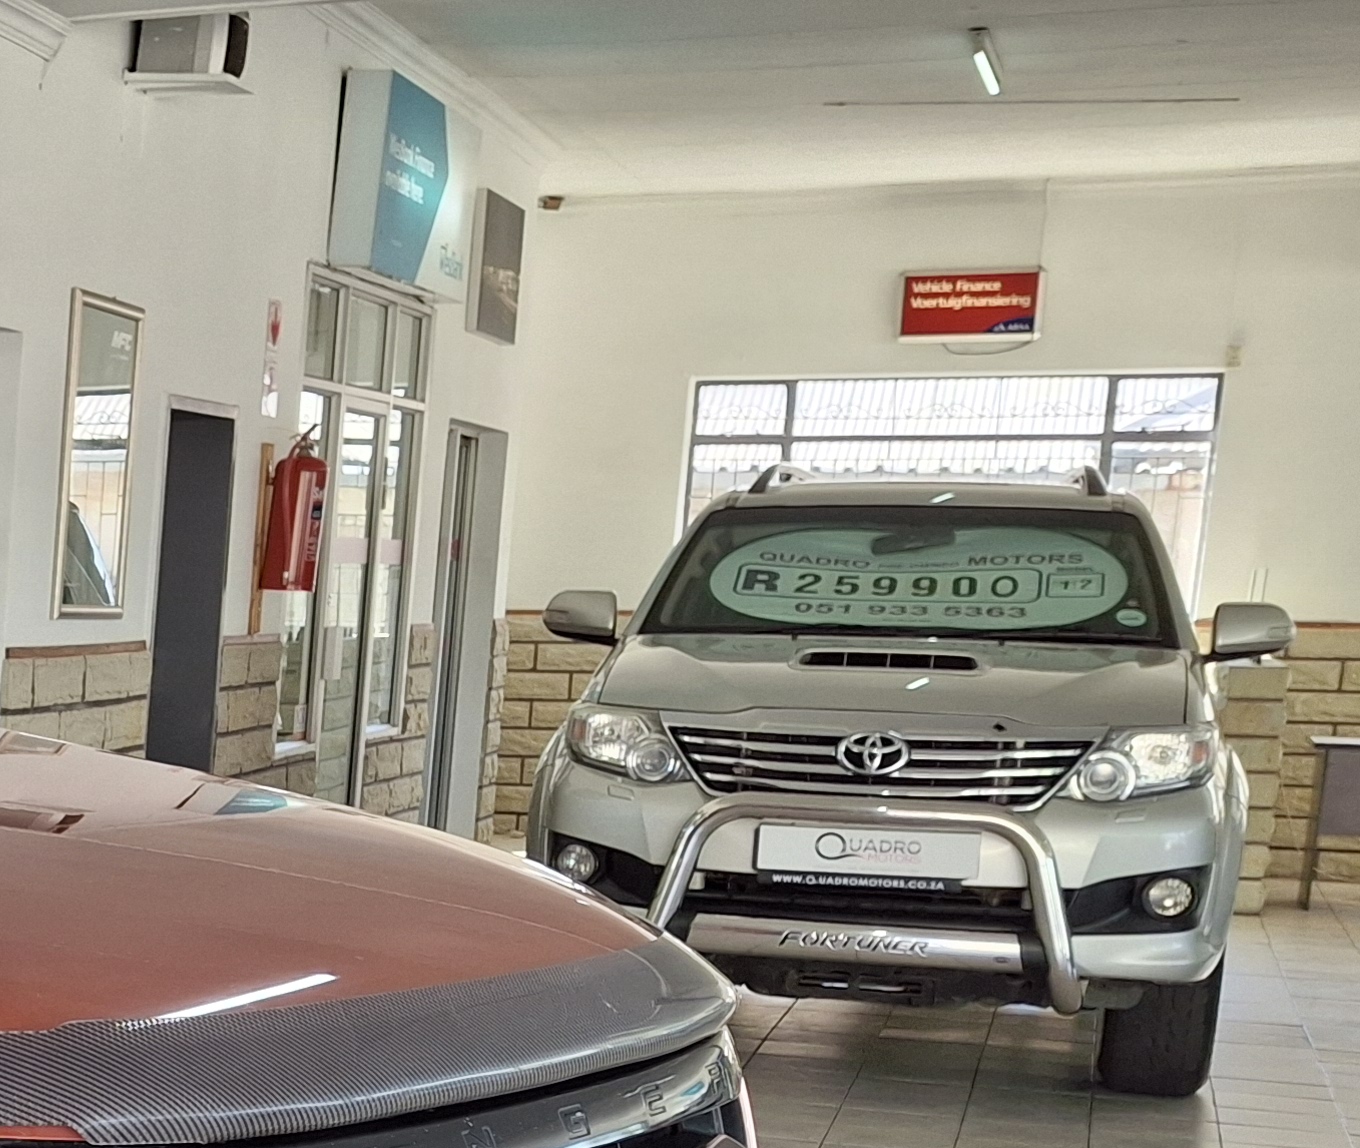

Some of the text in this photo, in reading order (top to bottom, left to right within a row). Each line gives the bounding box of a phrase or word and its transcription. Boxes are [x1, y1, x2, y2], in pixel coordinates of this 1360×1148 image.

[912, 279, 1002, 293] Vehicle Finance
[910, 293, 1032, 311] Voertuigfinansiering
[759, 551, 871, 569] QUADRO
[968, 554, 1085, 567] MOTORS
[741, 569, 1020, 598] R 259900
[794, 602, 852, 615] 051
[867, 604, 929, 617] 933
[815, 832, 922, 860] QUADRO
[772, 873, 945, 891] WWW.QUADROMOTORS.CO.ZA
[778, 929, 930, 958] FORTUNER
